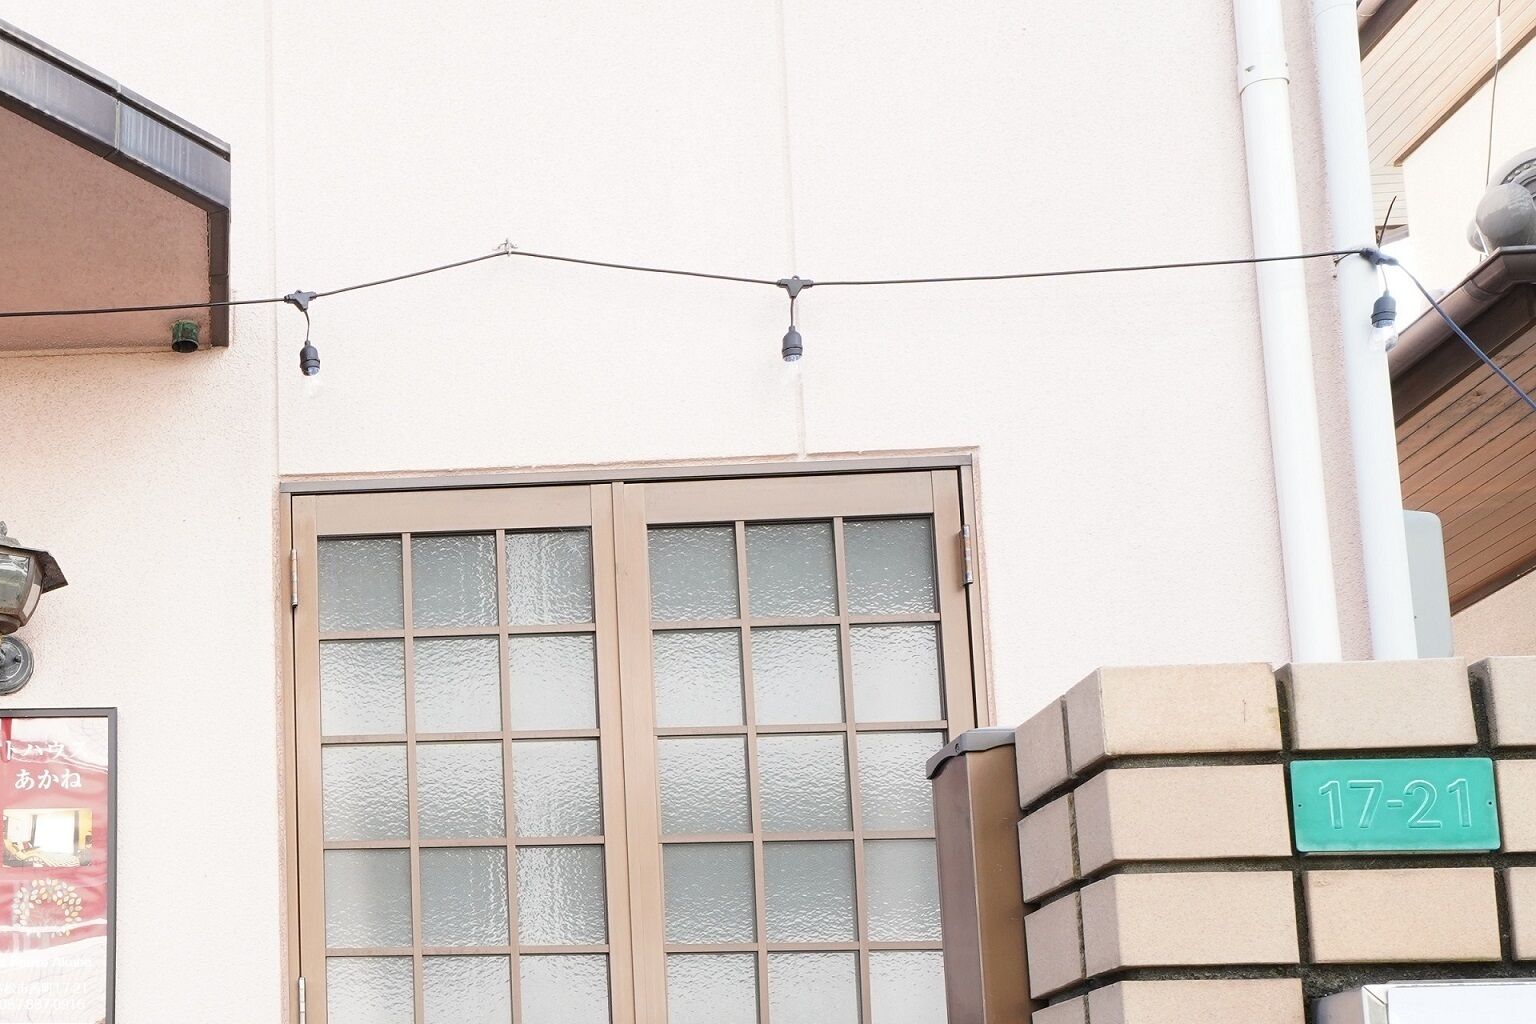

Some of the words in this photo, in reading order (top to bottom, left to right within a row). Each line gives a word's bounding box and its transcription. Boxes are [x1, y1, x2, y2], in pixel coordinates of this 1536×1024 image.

[15, 768, 82, 790] あかね
[1317, 777, 1473, 830] 17-21
